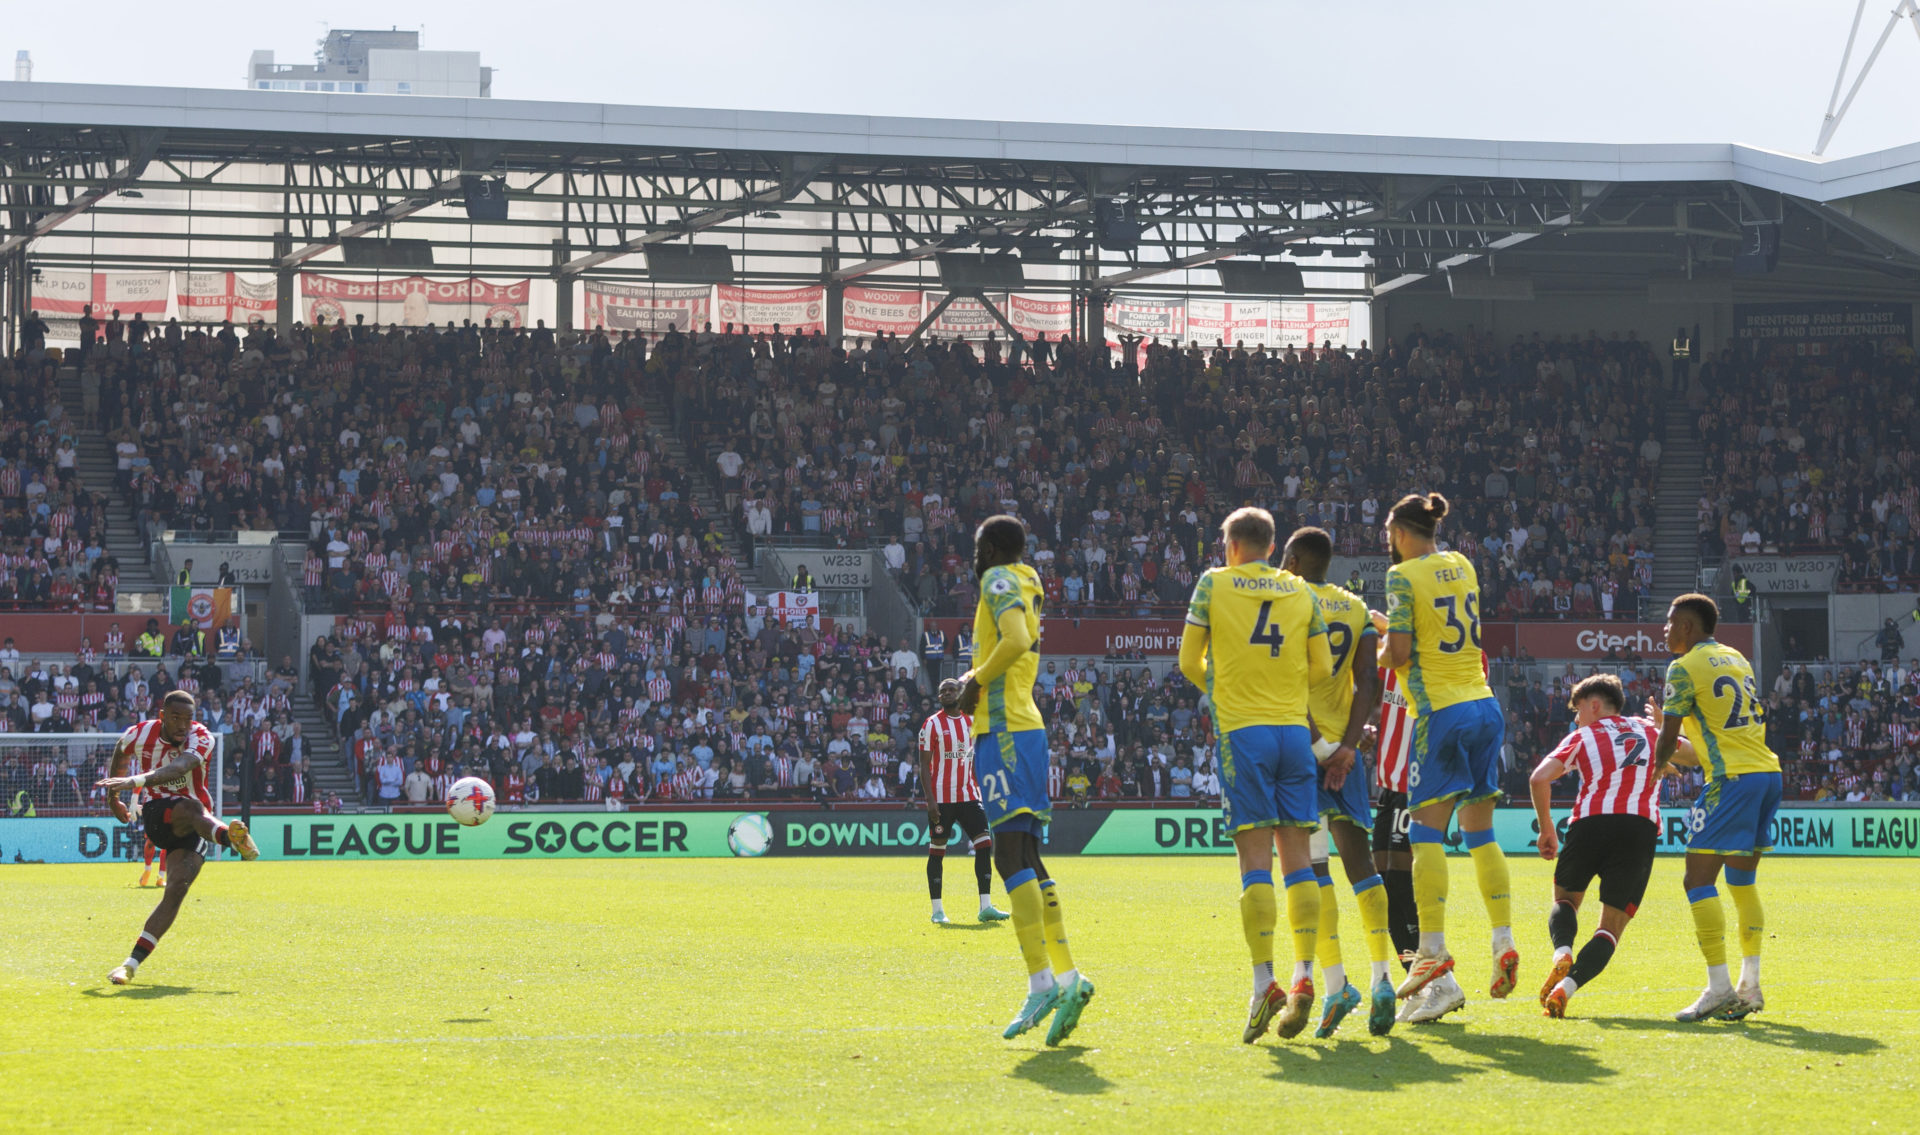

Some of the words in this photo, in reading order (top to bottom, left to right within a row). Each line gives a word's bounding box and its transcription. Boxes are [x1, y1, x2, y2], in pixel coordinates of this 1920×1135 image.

[62, 281, 86, 291] DAD
[116, 278, 160, 287] KINGSTON
[307, 277, 338, 293] MR
[347, 280, 485, 298] BRENTFORD
[493, 285, 522, 299] FC
[127, 287, 150, 295] BEES
[603, 284, 630, 296] BUZZING
[631, 289, 649, 297] FROM
[651, 289, 674, 298] BEFORE
[675, 287, 711, 298] LOCKDOWN
[719, 288, 733, 296] THE
[863, 291, 902, 302] WOODY
[195, 296, 263, 309] BRENTFORD
[1015, 299, 1049, 312] MOORS
[616, 309, 650, 319] EALING
[652, 311, 677, 320] ROAD
[859, 305, 878, 315] THE
[880, 308, 904, 317] BEES
[1128, 312, 1160, 320] FOREVER
[1239, 307, 1261, 315] MATT
[636, 319, 658, 328] BEES
[847, 319, 864, 328] ONE
[1123, 318, 1165, 327] BRENTFORD
[1198, 319, 1237, 328] ASHFORD
[1272, 320, 1330, 328] LITTLEHAMPTON
[1746, 314, 1809, 326] BRENTFORD
[1813, 313, 1842, 324] FANS
[1845, 311, 1895, 323] AGAINST
[1234, 332, 1265, 340] GINGER
[1323, 332, 1340, 340] DAN
[1782, 326, 1806, 337] AND
[1809, 324, 1906, 337] DISCRIMINATION
[822, 555, 862, 567] W233
[1359, 561, 1387, 573] W23
[1742, 561, 1777, 573] W231
[1785, 561, 1825, 573] W230
[822, 573, 859, 585] W133
[1768, 579, 1799, 590] W131
[1434, 591, 1482, 654] 38
[1249, 600, 1286, 658] 4
[1105, 634, 1163, 649] LONDON
[1614, 731, 1648, 769] 2
[982, 769, 1011, 803] 21
[1391, 807, 1411, 834] 10
[283, 822, 461, 857] LEAGUE
[503, 820, 690, 855] SOCCER
[1852, 817, 1920, 849] LEAGU
